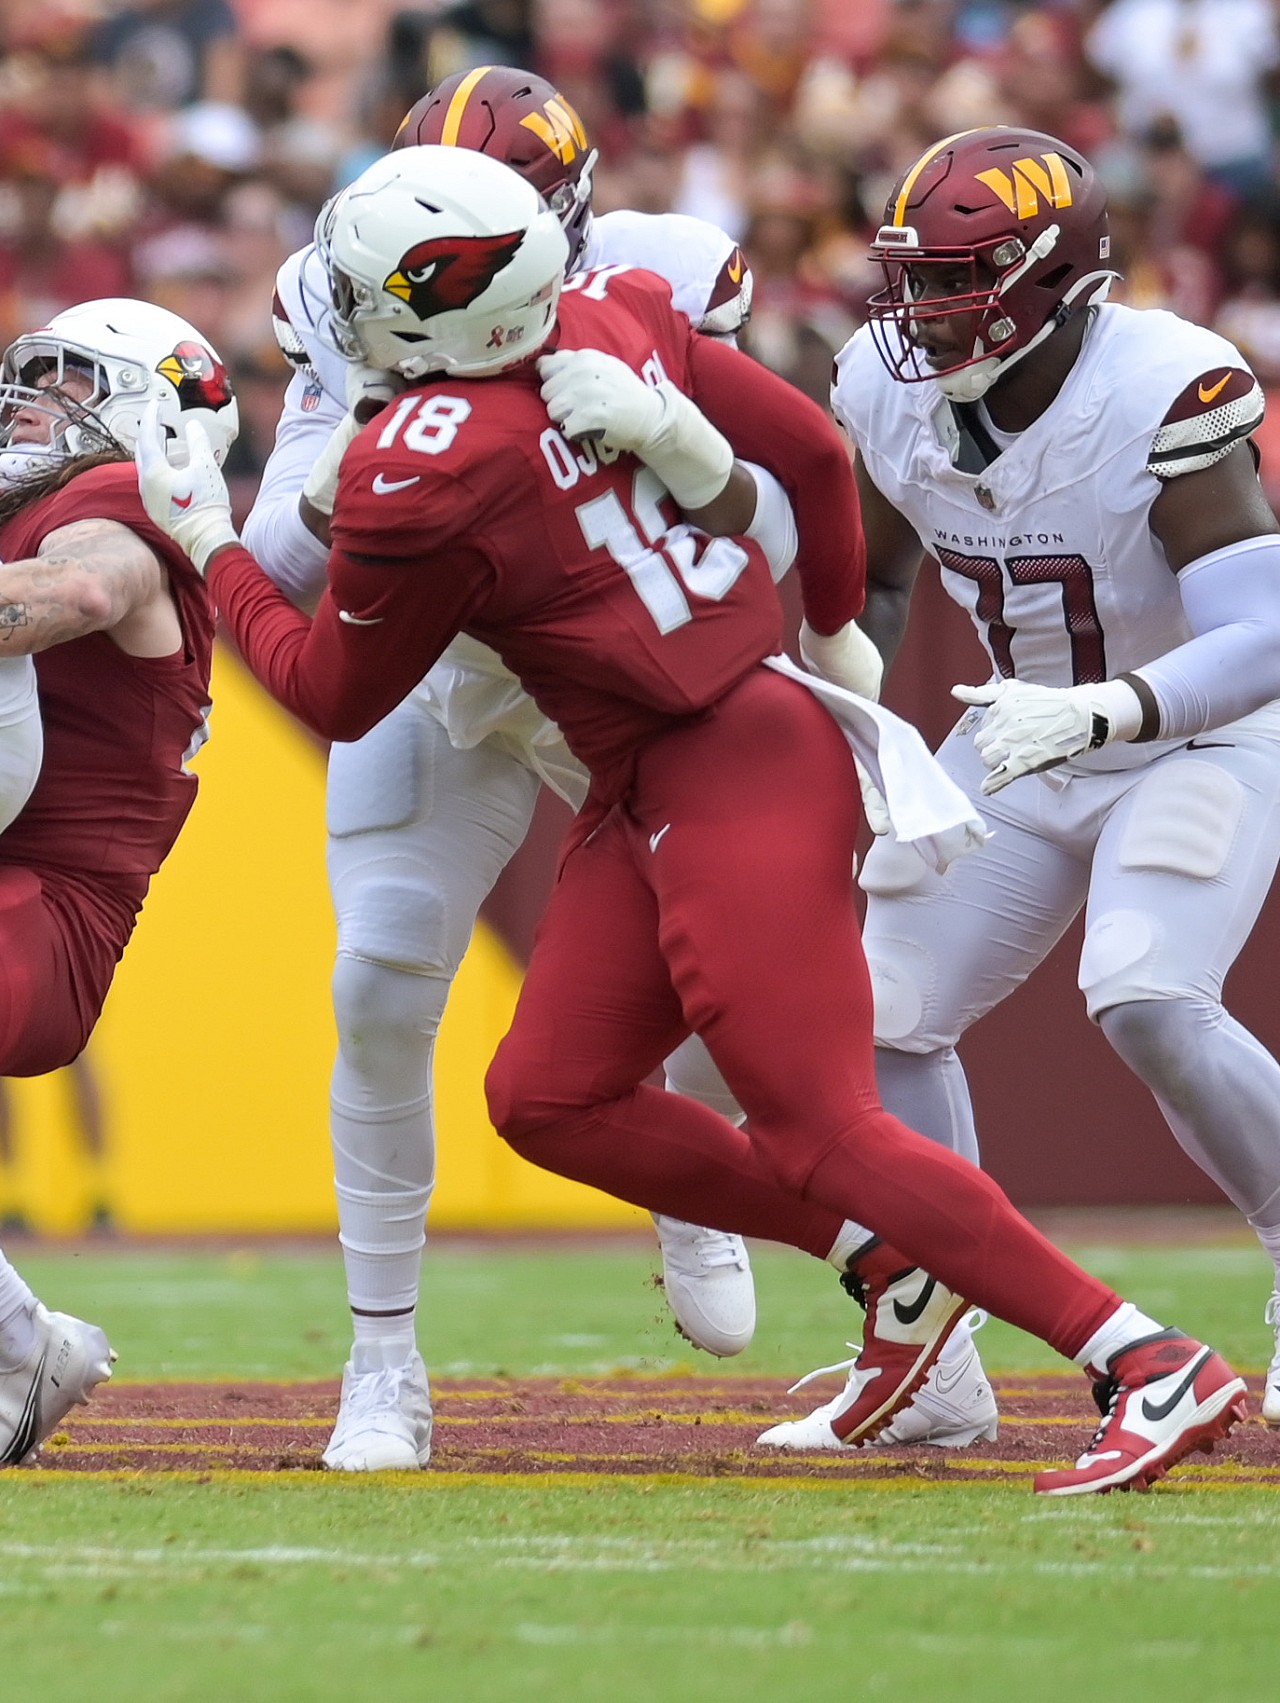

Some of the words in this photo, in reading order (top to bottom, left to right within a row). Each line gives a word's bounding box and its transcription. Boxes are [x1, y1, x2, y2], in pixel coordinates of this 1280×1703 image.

[973, 152, 1073, 221] W
[376, 394, 472, 455] 18
[574, 466, 750, 636] 18
[934, 528, 1064, 548] WASHINGTON
[932, 542, 1107, 686] 77
